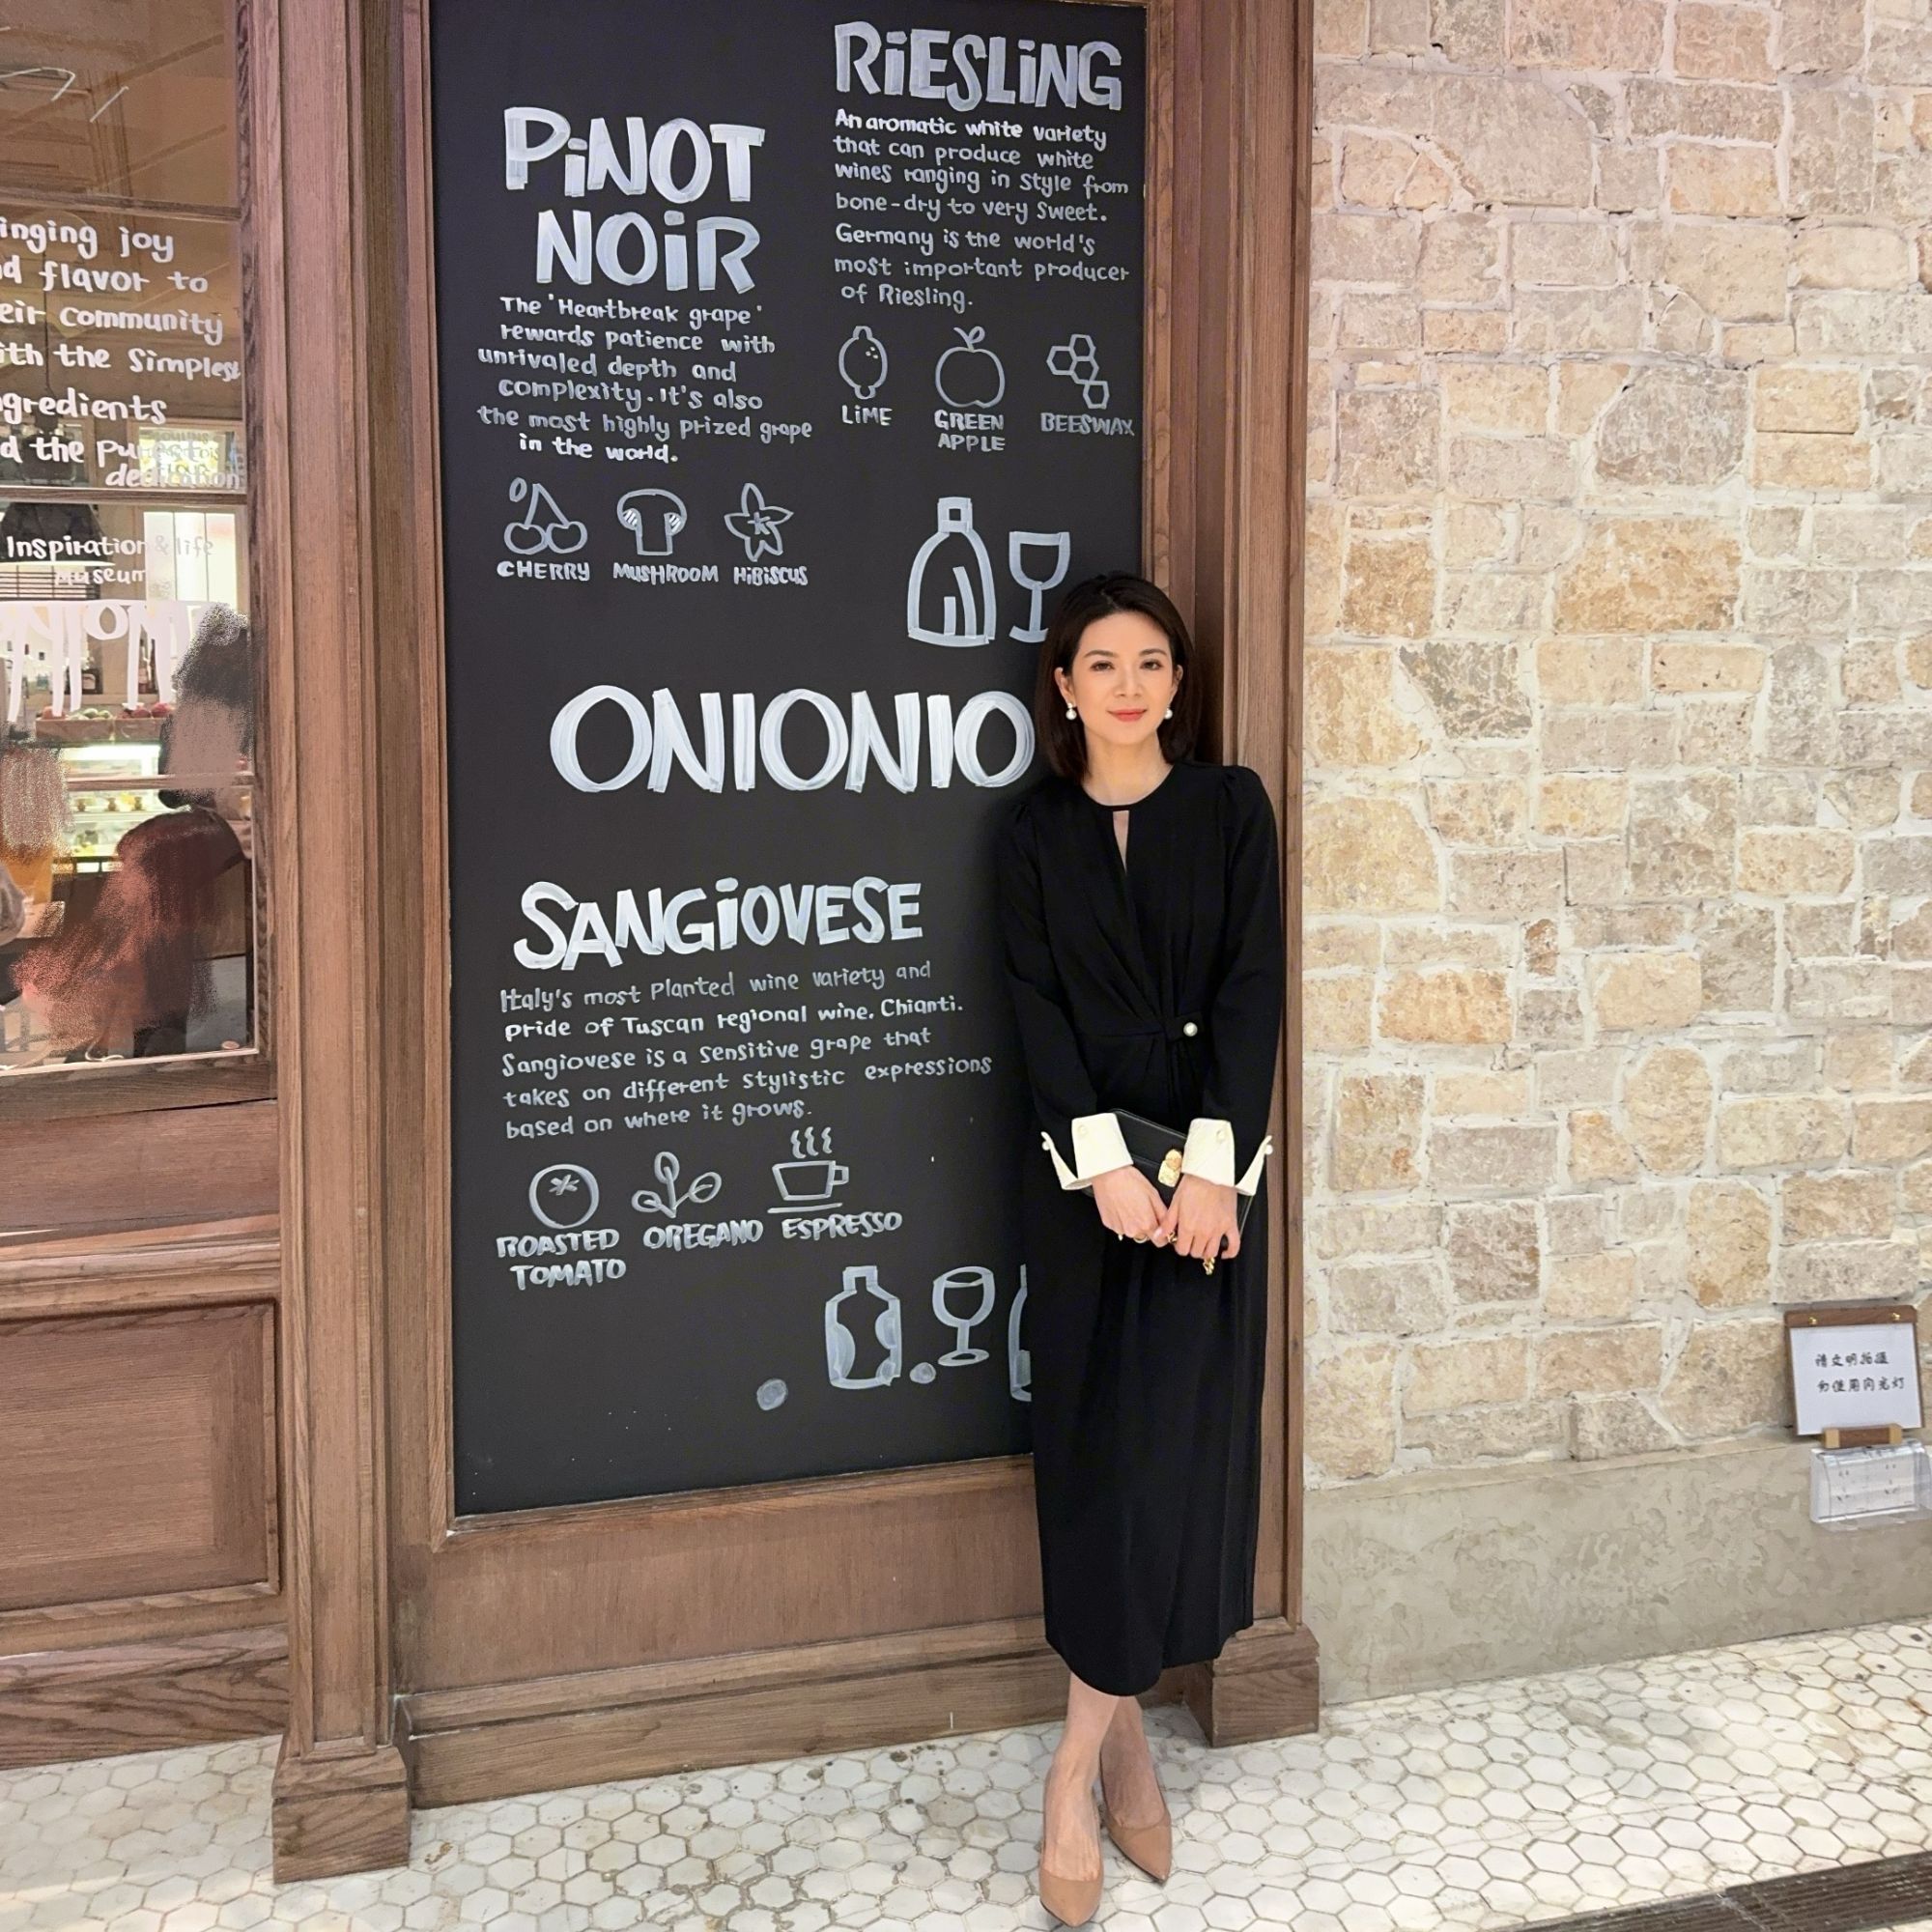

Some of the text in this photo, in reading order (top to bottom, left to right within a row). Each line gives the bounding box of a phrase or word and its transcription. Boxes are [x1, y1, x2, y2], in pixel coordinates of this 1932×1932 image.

[836, 108, 1107, 152] An aromatic white variety
[833, 135, 1094, 169] that can produce white
[835, 162, 892, 183] wines
[904, 166, 980, 194] ranging
[992, 170, 1009, 187] in
[1083, 175, 1128, 199] from
[837, 192, 940, 221] bone-dry
[947, 198, 975, 214] to
[982, 202, 1028, 224] very
[118, 226, 174, 263] joy
[836, 223, 1094, 256] Germany is the world's
[0, 254, 209, 293] d flavor to
[835, 257, 1129, 281] most important producer
[499, 297, 541, 314] The
[841, 283, 972, 314] of Riesling.
[60, 306, 223, 347] community
[500, 325, 775, 354] rewards patience with
[52, 343, 112, 368] the
[478, 349, 736, 382] unrivaled depth and
[0, 386, 167, 425] gredients
[660, 385, 702, 409] It's
[714, 388, 762, 410] also
[477, 406, 811, 443] the most highly prized grape
[934, 410, 1004, 431] GREEN
[1041, 412, 1134, 436] BEESWAX
[29, 436, 84, 464] the
[519, 433, 678, 464] in the world.
[938, 433, 1005, 451] APPLE
[497, 560, 589, 581] CHERRY
[550, 685, 1035, 794] ONIONIO
[500, 987, 572, 1012] Italy's
[584, 985, 641, 1006] most
[750, 974, 799, 991] wine
[812, 968, 885, 989] variety
[896, 960, 930, 979] and
[505, 1019, 571, 1041] pride
[585, 1017, 614, 1037] of
[620, 1017, 703, 1037] Tuscan
[717, 1006, 807, 1034] regional
[502, 1028, 931, 1080] Sangiovese is a sensitive grape that
[502, 1057, 991, 1108] takes on different stylistic expressions
[506, 1116, 574, 1139] based
[584, 1119, 612, 1132] on
[624, 1110, 690, 1128] where
[702, 1104, 723, 1121] it
[643, 1220, 763, 1251] OREGANO
[781, 1211, 902, 1240] ESPRESSO
[510, 1259, 626, 1291] TOMATO
